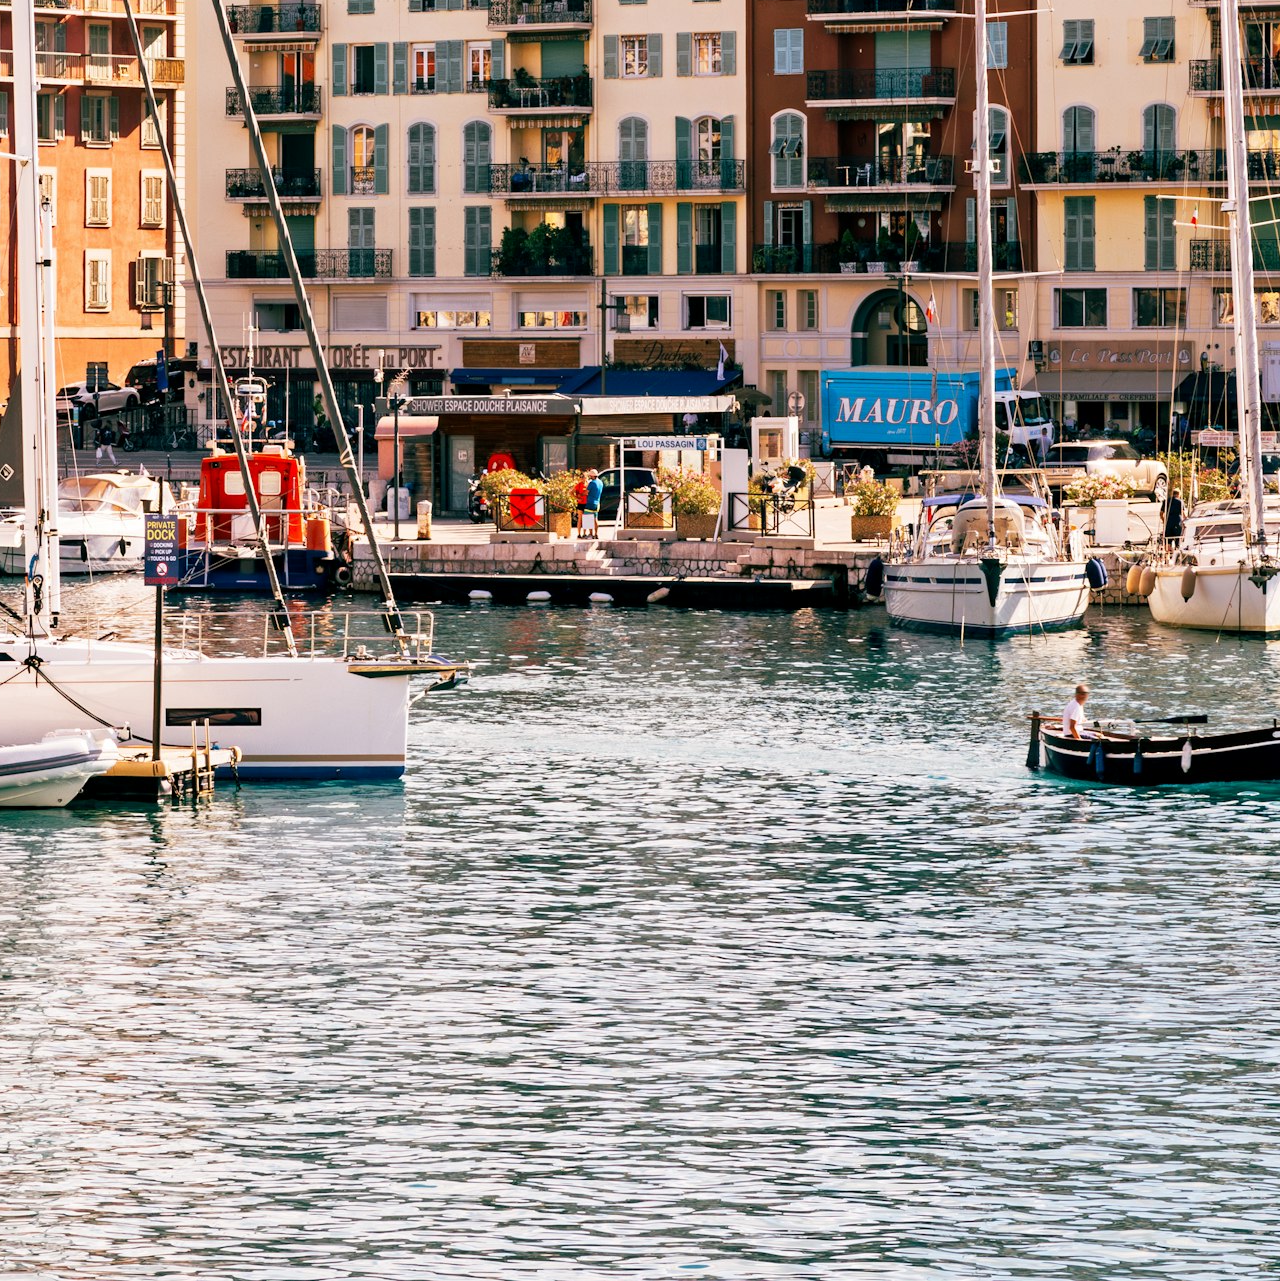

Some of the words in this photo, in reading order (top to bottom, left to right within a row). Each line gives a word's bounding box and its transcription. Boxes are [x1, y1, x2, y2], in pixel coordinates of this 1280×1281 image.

[212, 347, 302, 367] ESTAURANT
[399, 348, 436, 367] PORT
[643, 341, 703, 366] Duchesse
[1069, 348, 1090, 363] Le
[411, 400, 443, 412] SHOWER
[444, 401, 472, 412] ESPACE
[474, 400, 504, 412] DOUCHE
[506, 400, 547, 412] PLAISANCE
[835, 397, 959, 425] MAURO
[147, 521, 176, 529] PRIVATE
[147, 529, 176, 540] DOCK
